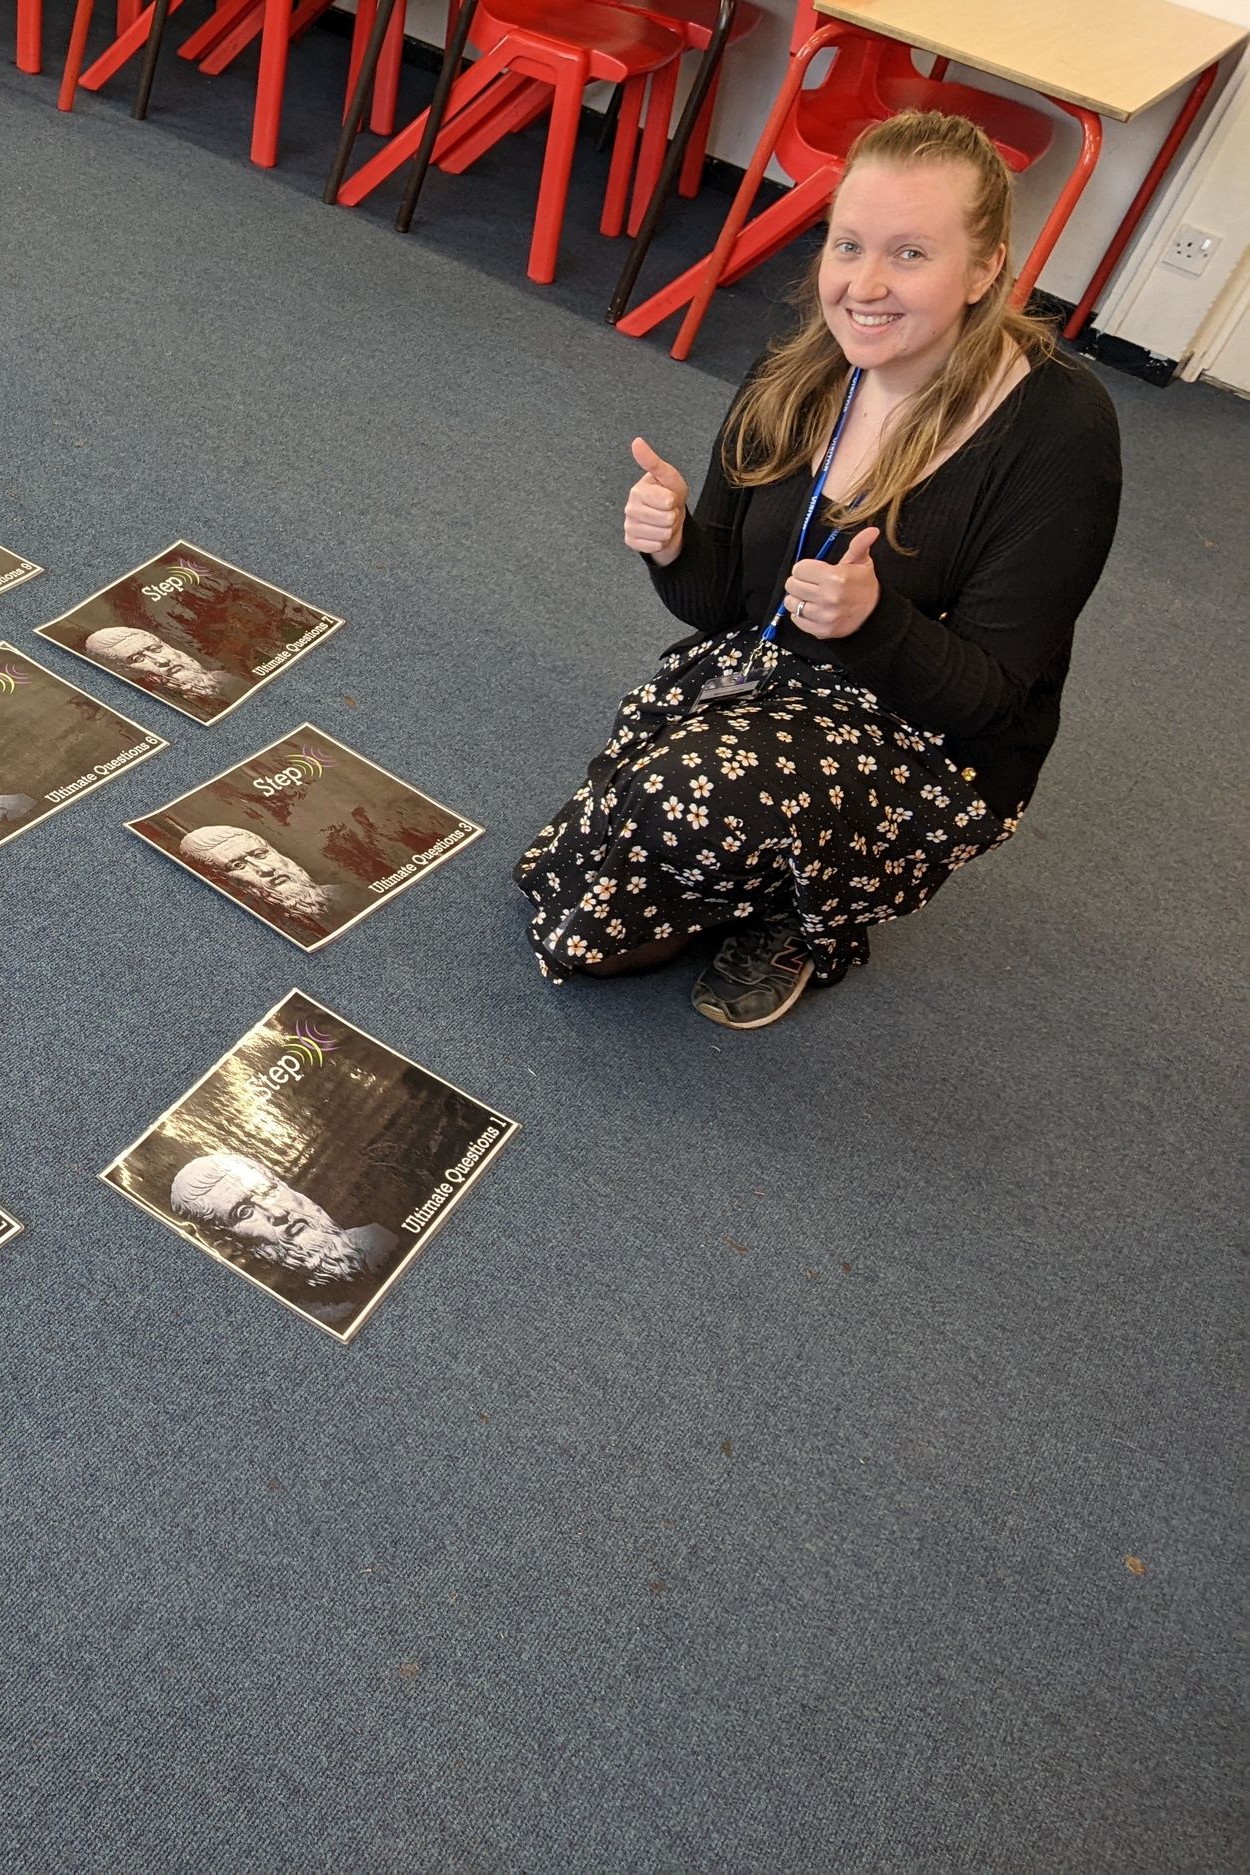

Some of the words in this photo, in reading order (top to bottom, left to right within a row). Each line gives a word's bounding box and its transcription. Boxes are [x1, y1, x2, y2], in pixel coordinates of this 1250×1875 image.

[20, 562, 33, 573] 9
[141, 576, 183, 602] Step
[252, 650, 291, 677] Ultimate
[286, 622, 328, 653] Questions
[321, 616, 334, 628] 7
[45, 773, 98, 803] Ultimate
[94, 741, 150, 775] Questions
[148, 736, 158, 747] 6
[253, 766, 302, 797] Step
[369, 862, 418, 893] Ultimate
[412, 828, 464, 866] Questions
[461, 822, 473, 832] 3
[401, 1182, 454, 1234] Ultimate
[445, 1126, 500, 1183] Questions
[494, 1116, 507, 1130] 1
